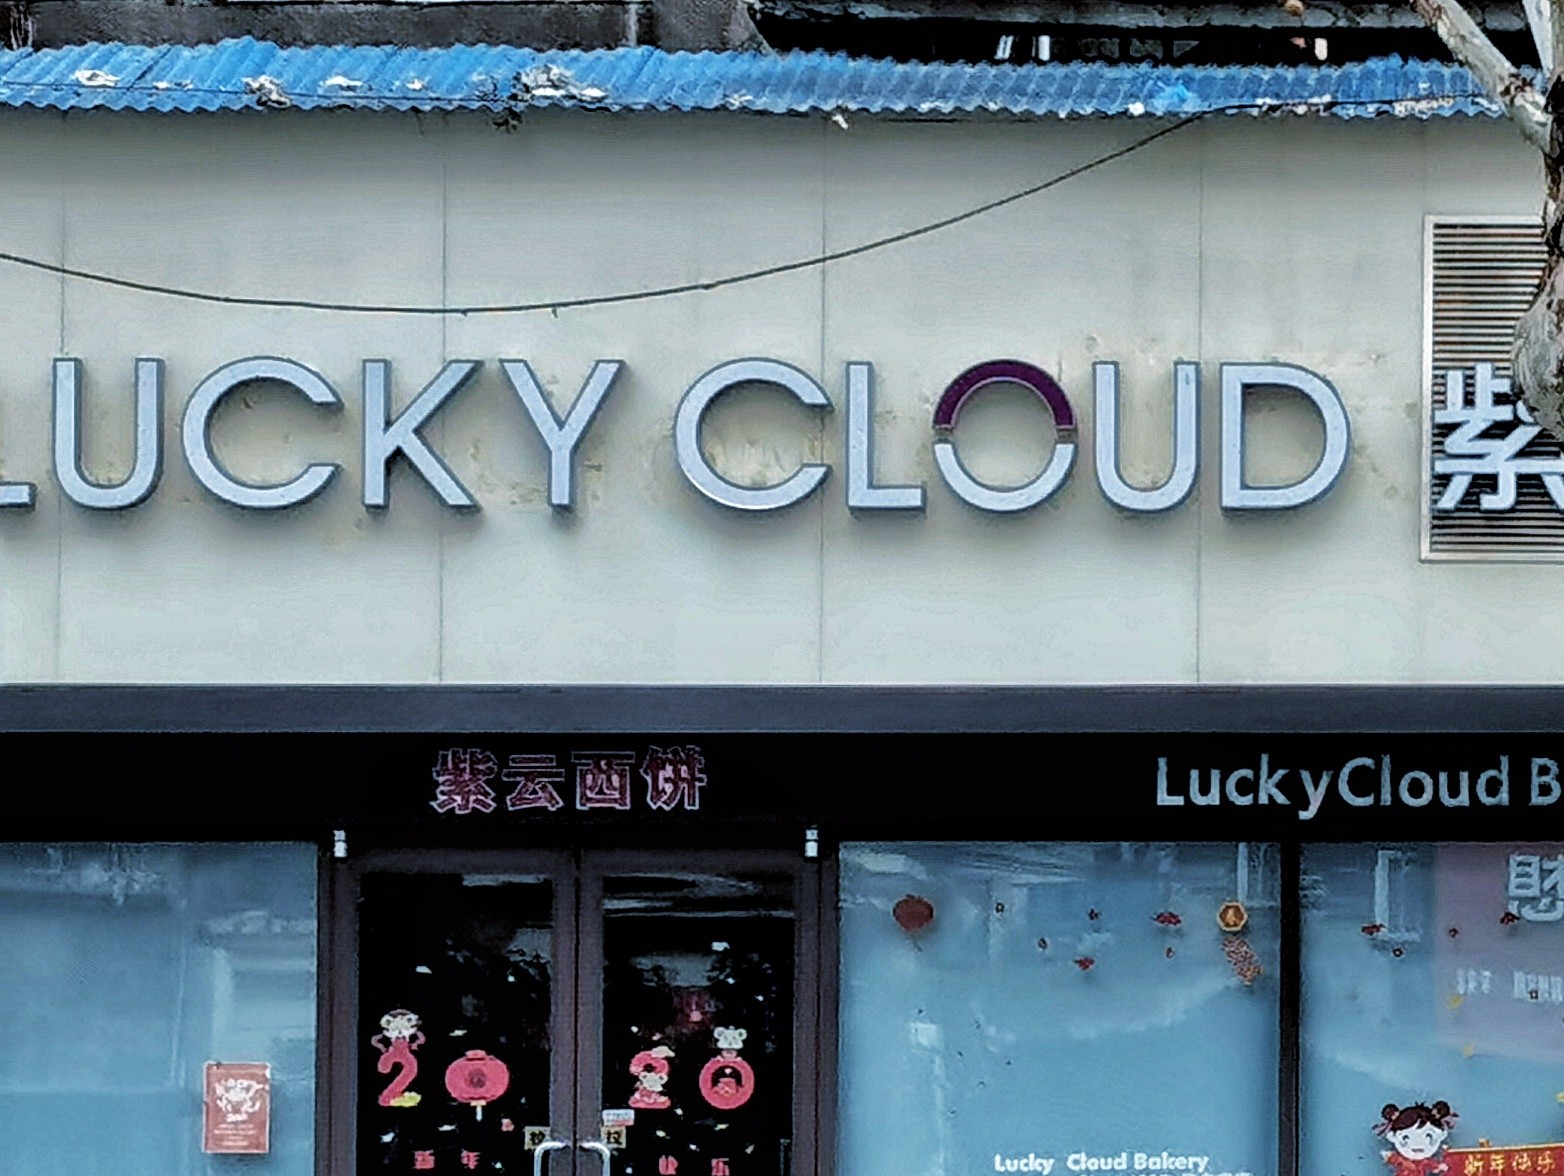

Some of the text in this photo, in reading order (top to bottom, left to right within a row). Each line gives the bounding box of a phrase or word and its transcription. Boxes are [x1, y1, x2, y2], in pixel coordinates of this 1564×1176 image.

[674, 356, 1352, 514] CLOUD
[431, 744, 708, 816] 紫云西饼
[993, 1151, 1210, 1176] Lucky Cloud Bakery
